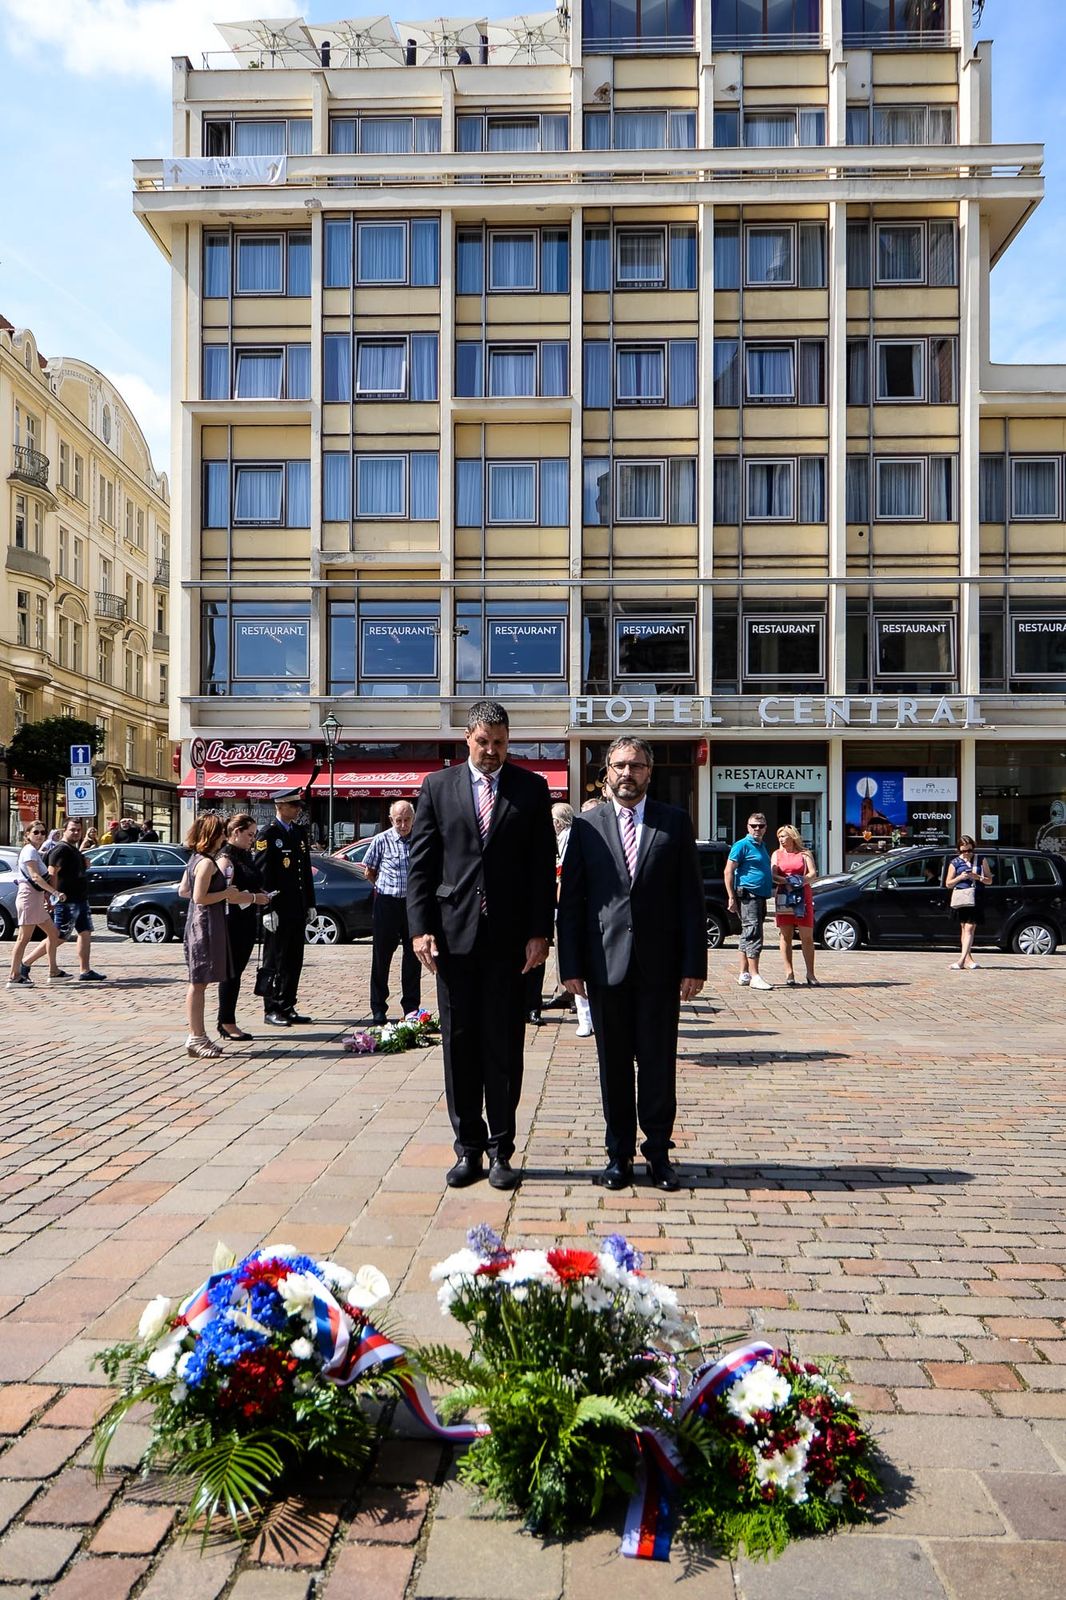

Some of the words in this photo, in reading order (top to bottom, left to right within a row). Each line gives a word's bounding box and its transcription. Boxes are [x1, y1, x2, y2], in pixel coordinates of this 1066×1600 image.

[241, 626, 303, 636] RESTAURANT
[369, 626, 431, 635] RESTAURANT
[495, 626, 557, 635] RESTAURANT
[623, 626, 686, 635] RESTAURANT
[752, 624, 816, 634] RESTAURANT
[882, 624, 947, 633] RESTAURANT
[570, 697, 724, 724] HOTEL
[758, 697, 986, 724] CENTRAL
[207, 740, 296, 766] CrossCafe
[725, 769, 814, 780] RESTAURANT
[756, 782, 795, 790] RECEPCE
[22, 791, 40, 804] Expert
[912, 811, 952, 820] OTEVŘENO
